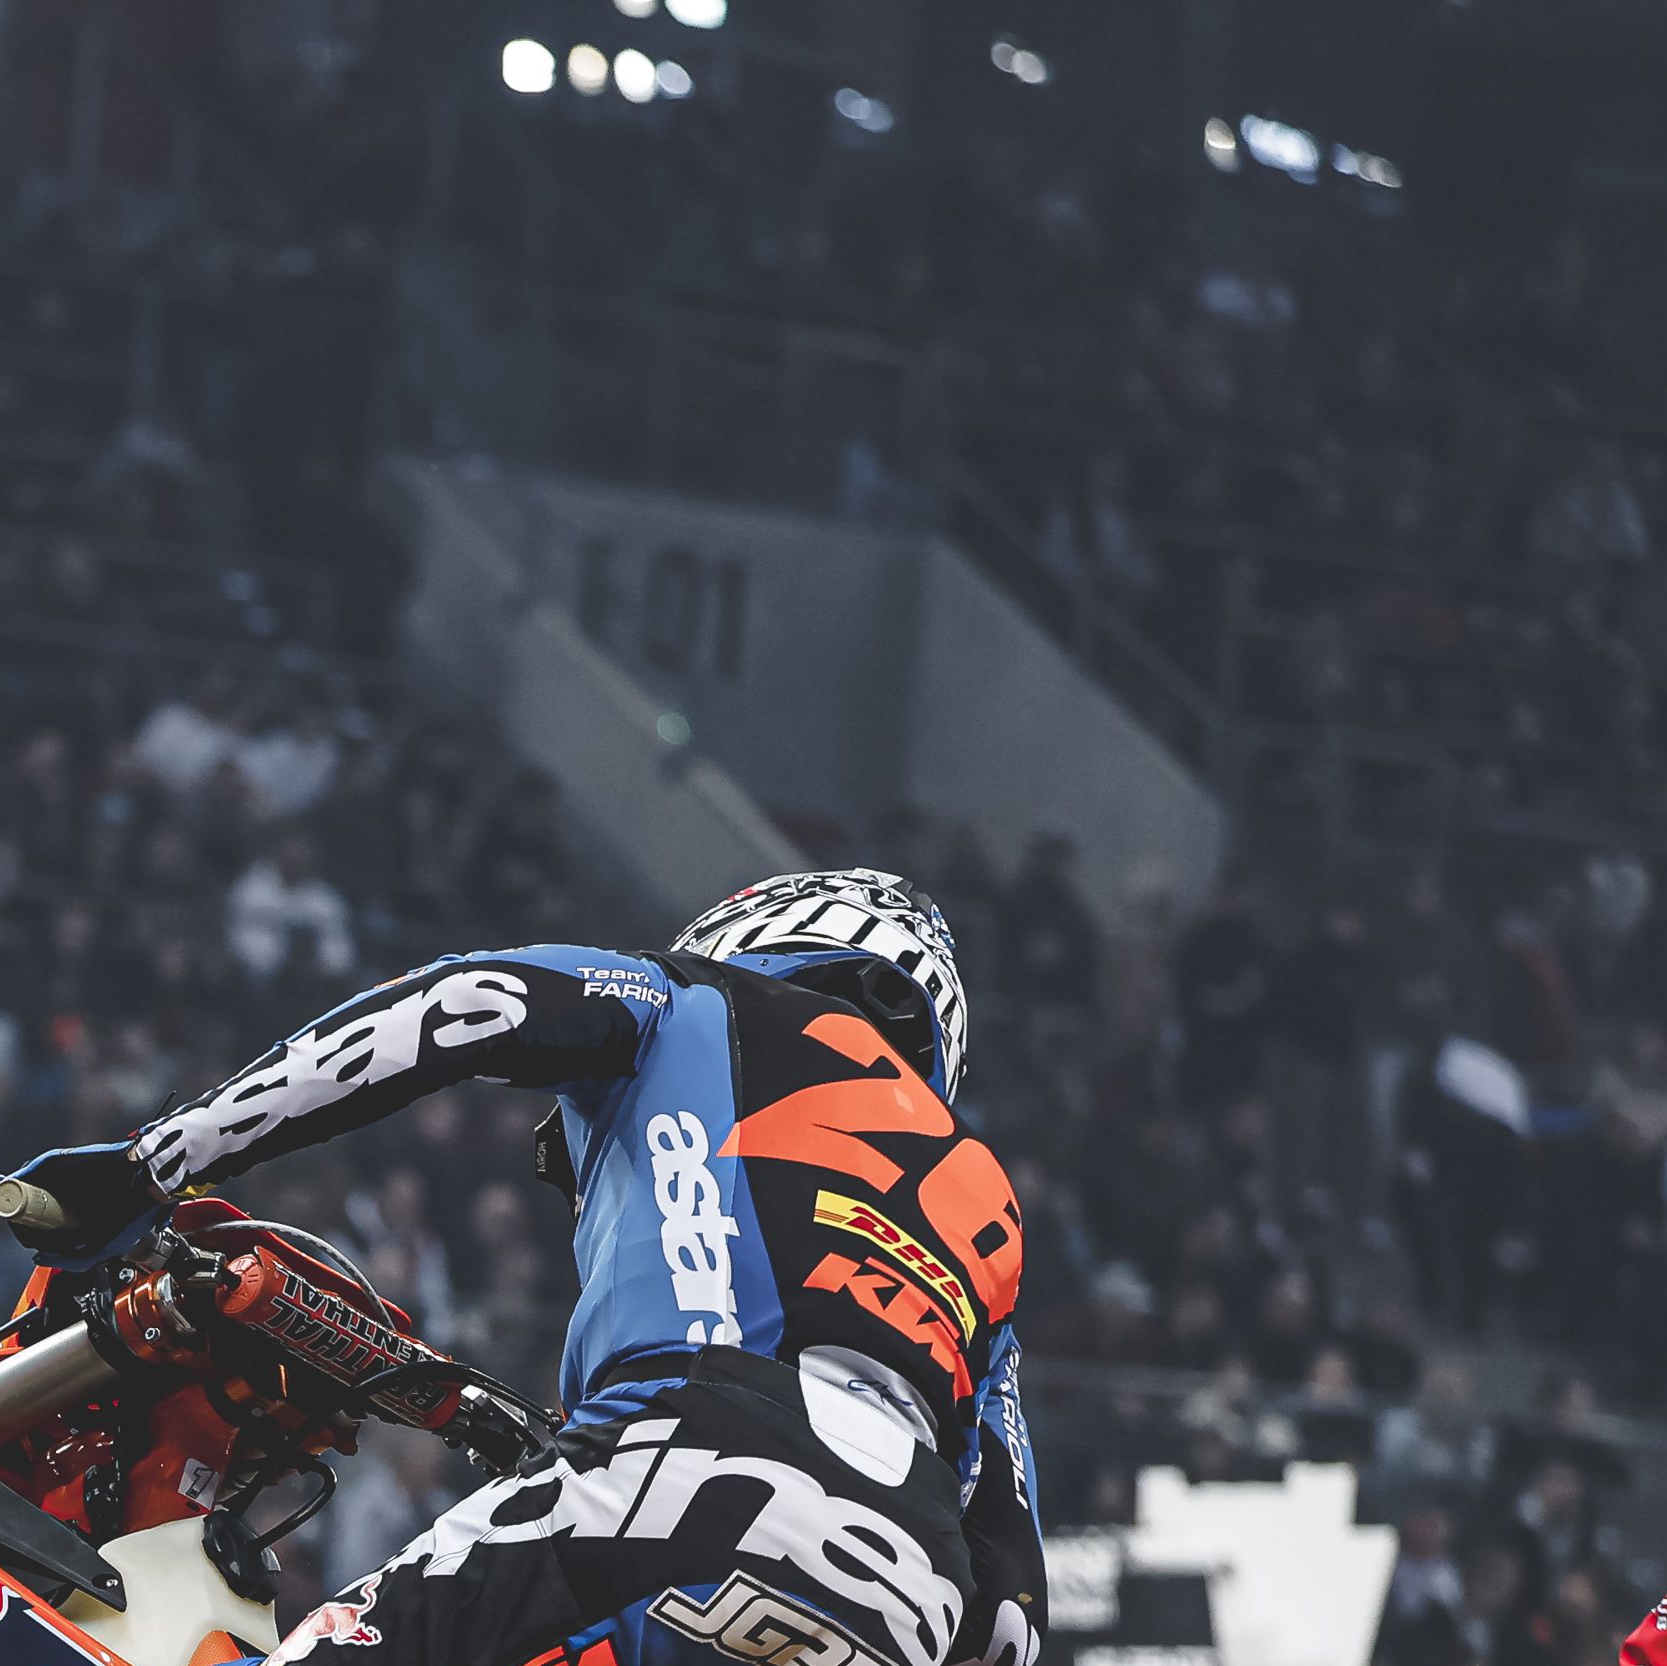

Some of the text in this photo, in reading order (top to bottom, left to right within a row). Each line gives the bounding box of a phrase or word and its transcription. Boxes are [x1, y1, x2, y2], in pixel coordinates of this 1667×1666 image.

[576, 966, 650, 983] Team
[135, 970, 528, 1197] astars
[272, 1260, 439, 1367] ENTHAL
[845, 1205, 964, 1319] DHL
[802, 1252, 973, 1402] KTM
